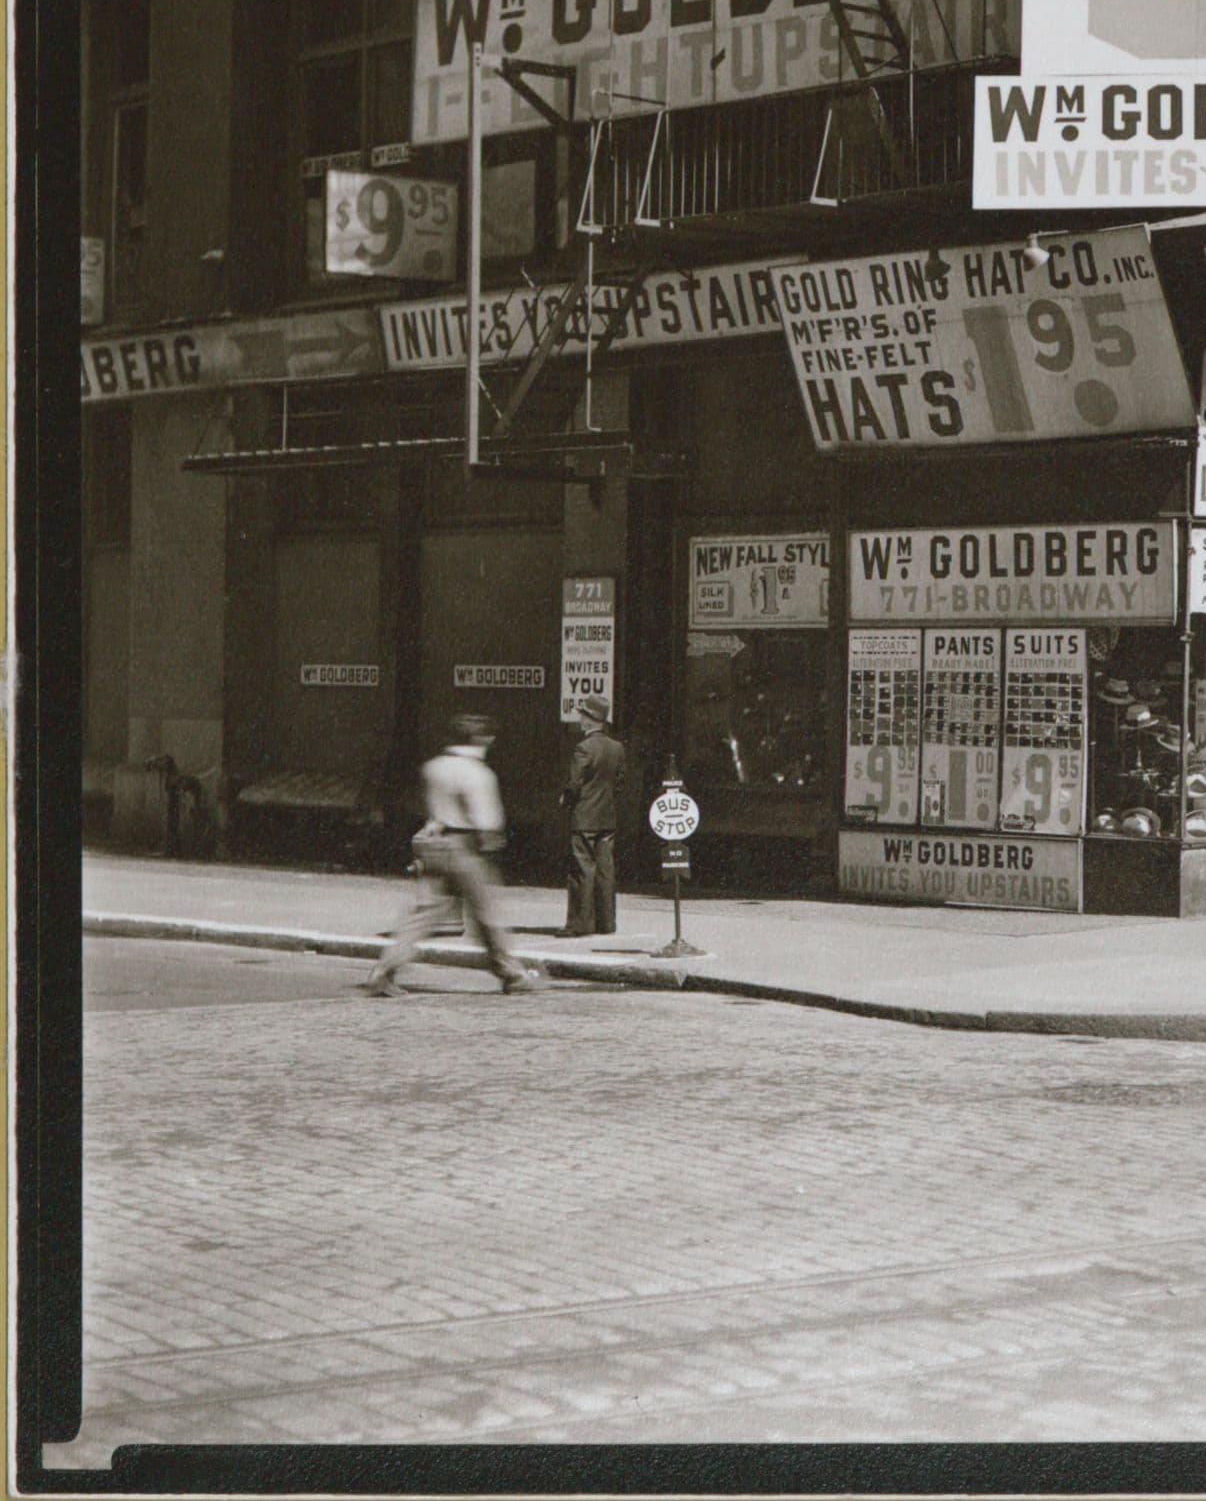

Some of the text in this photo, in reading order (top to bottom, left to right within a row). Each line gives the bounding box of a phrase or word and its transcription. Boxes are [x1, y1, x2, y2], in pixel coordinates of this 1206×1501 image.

[780, 267, 857, 315] GOLD
[869, 258, 949, 305] RING
[963, 250, 1030, 299] HAT
[1115, 255, 1155, 283] INC.
[603, 269, 782, 342] UPSTAIR
[904, 306, 937, 335] OF
[805, 370, 965, 442] HATS
[696, 546, 732, 577] NEW
[736, 544, 778, 568] FALL
[930, 528, 1159, 579] GOLDBERG
[574, 583, 602, 598] 771
[564, 601, 613, 613] BROADWAY
[575, 625, 611, 642] GOLDBERG
[935, 636, 995, 656] PANTS
[1013, 634, 1079, 655] SUITS
[319, 667, 378, 683] GOLDBERG
[477, 668, 542, 685] GOLDBERG
[565, 661, 609, 674] INVITES
[569, 677, 604, 694] YOU
[656, 797, 690, 813] BUS
[655, 816, 696, 835] STOP
[917, 840, 1034, 871] GOLDBERG
[842, 864, 1071, 902] INVITES YOU UPSTAIRS
